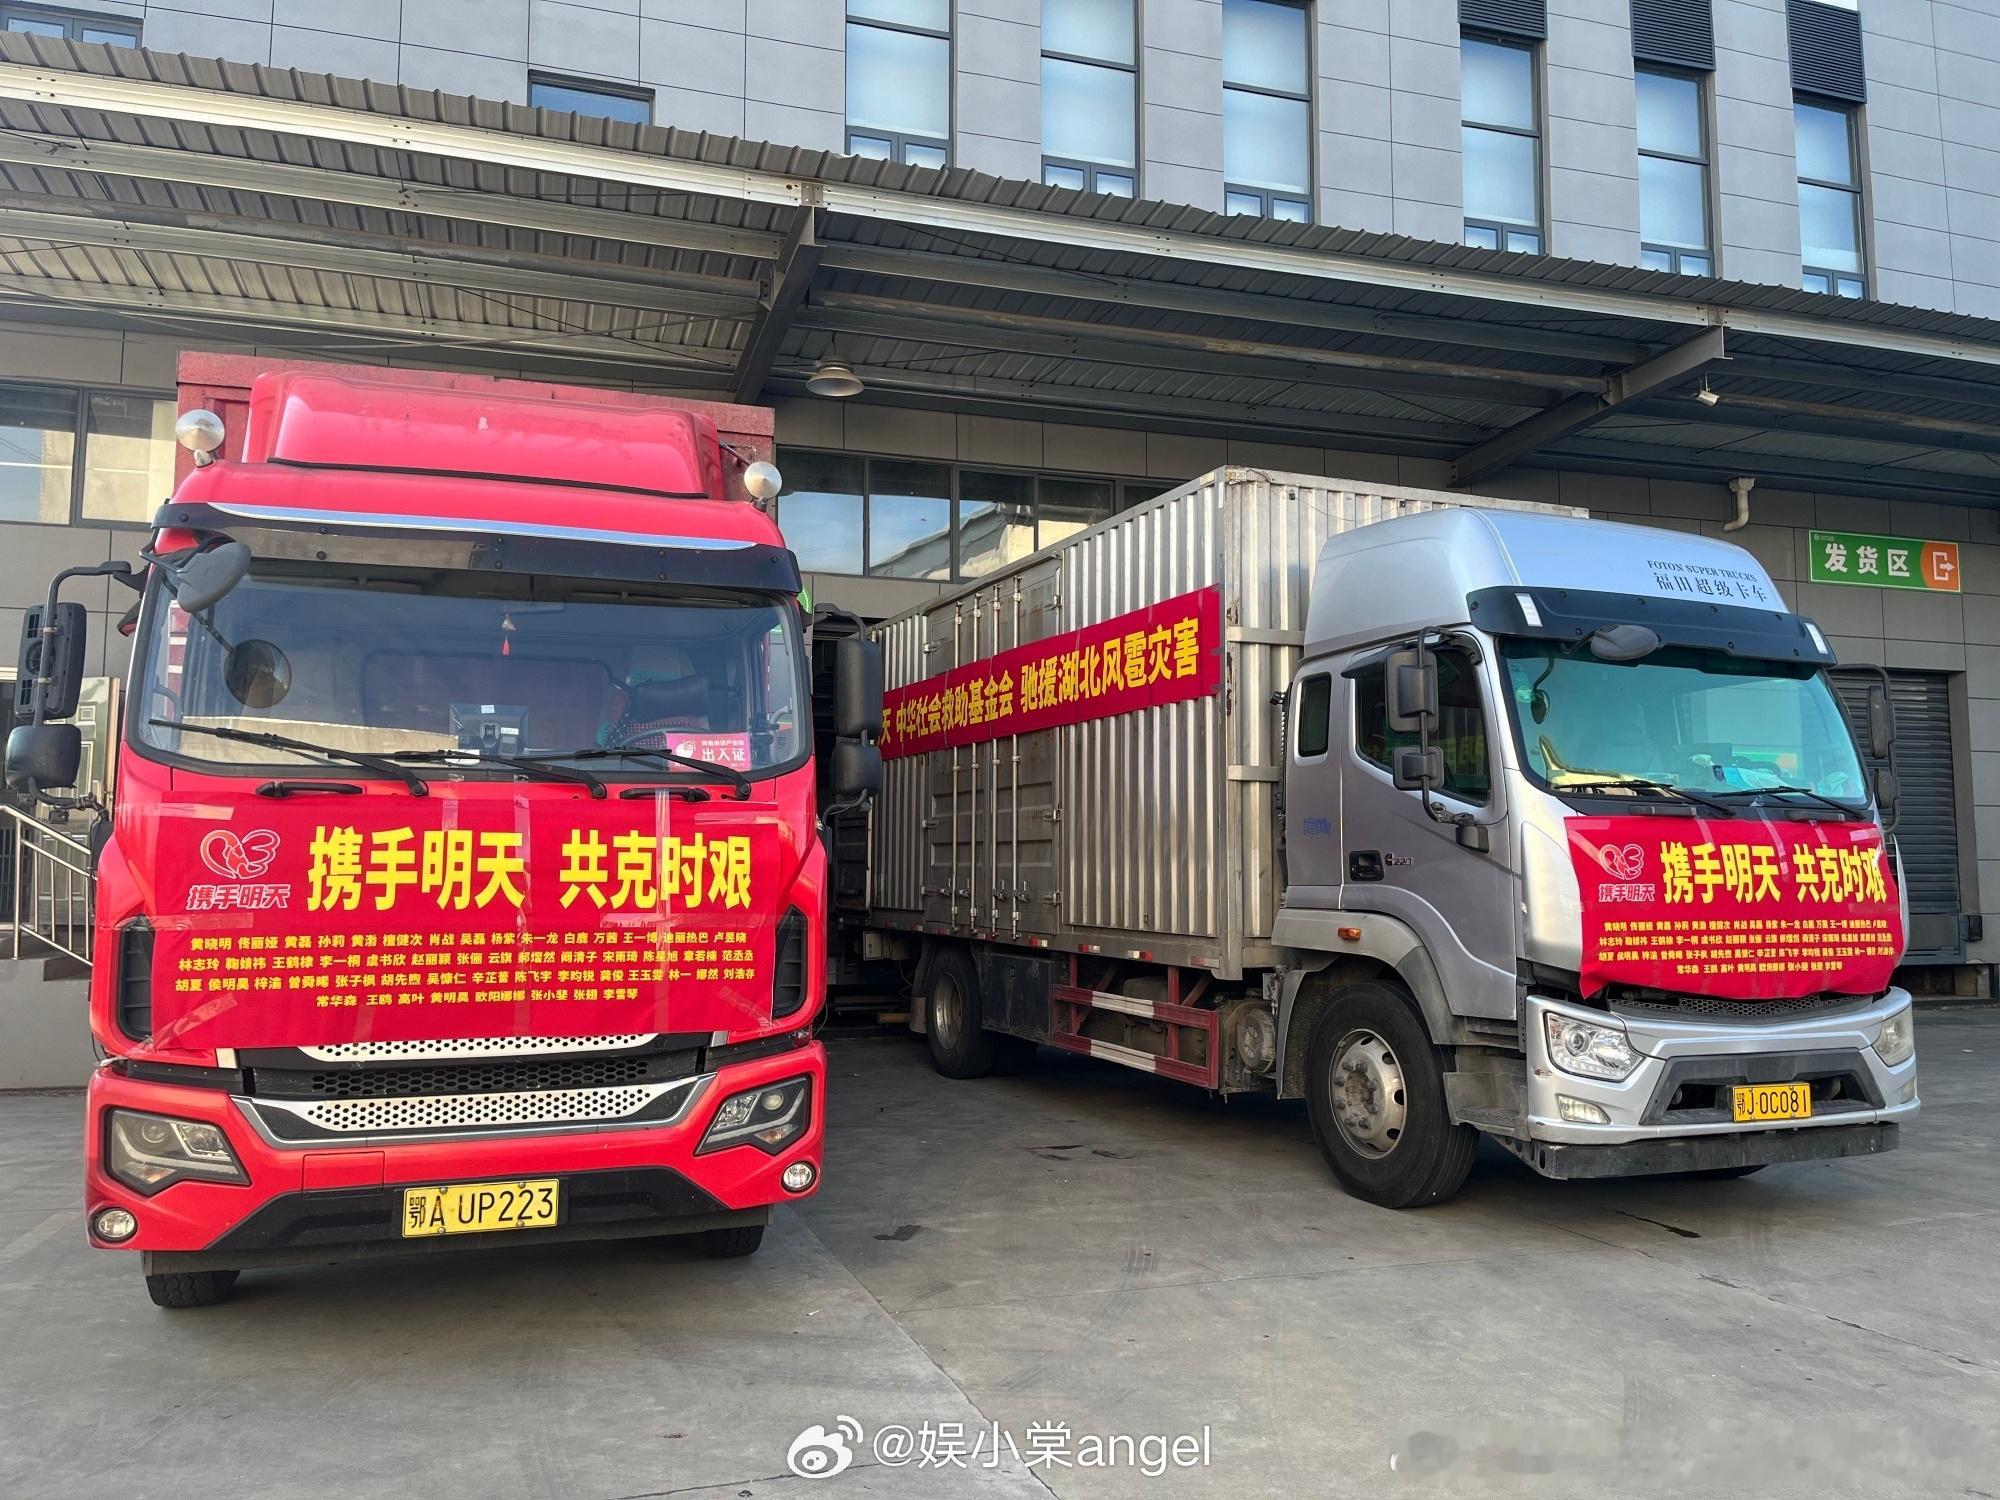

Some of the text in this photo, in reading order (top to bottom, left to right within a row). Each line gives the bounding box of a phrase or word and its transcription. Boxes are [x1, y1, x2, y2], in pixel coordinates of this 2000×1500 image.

[1647, 560, 1758, 583] FOTON SUPER TRUCKS
[1824, 543, 1910, 577] 发货区
[1654, 572, 1767, 602] 福田超级卡车
[877, 616, 1200, 746] 天 中华社会救助基金会 驰援湖北风雹灾害
[702, 747, 746, 762] 出入证
[307, 826, 752, 911] 携手明天 共克时艰
[1660, 842, 1887, 904] 携手明天 共克时艰
[186, 884, 291, 910] 携手明天
[1599, 883, 1656, 902] 携手明天
[190, 938, 233, 951] 黄晓明
[284, 936, 312, 949] 黄磊
[317, 935, 345, 948] 孙莉
[351, 935, 378, 948] 黄渤
[382, 934, 423, 947] 檀健次
[429, 934, 455, 946] 肖战
[460, 933, 486, 946] 吴磊
[490, 933, 516, 945] 杨紫
[521, 932, 559, 944] 朱一龙
[564, 932, 588, 944] 白鹿
[594, 932, 618, 944] 万茜
[623, 932, 658, 943] 王一博
[663, 931, 708, 943] 迪丽热巴
[714, 932, 747, 943] 卢昱晓
[178, 958, 221, 972] 林志玲
[319, 955, 361, 968] 李一桐
[366, 954, 407, 967] 虞书欣
[411, 953, 452, 966] 赵丽颖
[456, 953, 483, 965] 张俪
[488, 952, 513, 964] 云旗
[643, 951, 678, 962] 陈星旭
[683, 950, 718, 962] 章若楠
[722, 950, 754, 962] 范丞丞
[175, 979, 202, 992] 胡夏
[208, 978, 250, 992] 侯明昊
[253, 977, 282, 990] 梓渝
[335, 975, 376, 988] 张子枫
[514, 971, 553, 983] 陈飞宇
[557, 970, 595, 983] 李昀锐
[668, 968, 691, 979] 林一
[723, 968, 755, 980] 刘浩存
[316, 995, 358, 1008] 常华森
[398, 993, 425, 1005] 高叶
[430, 992, 470, 1004] 黄明昊
[474, 990, 526, 1002] 欧阳娜娜
[603, 989, 638, 1001] 李雪琴
